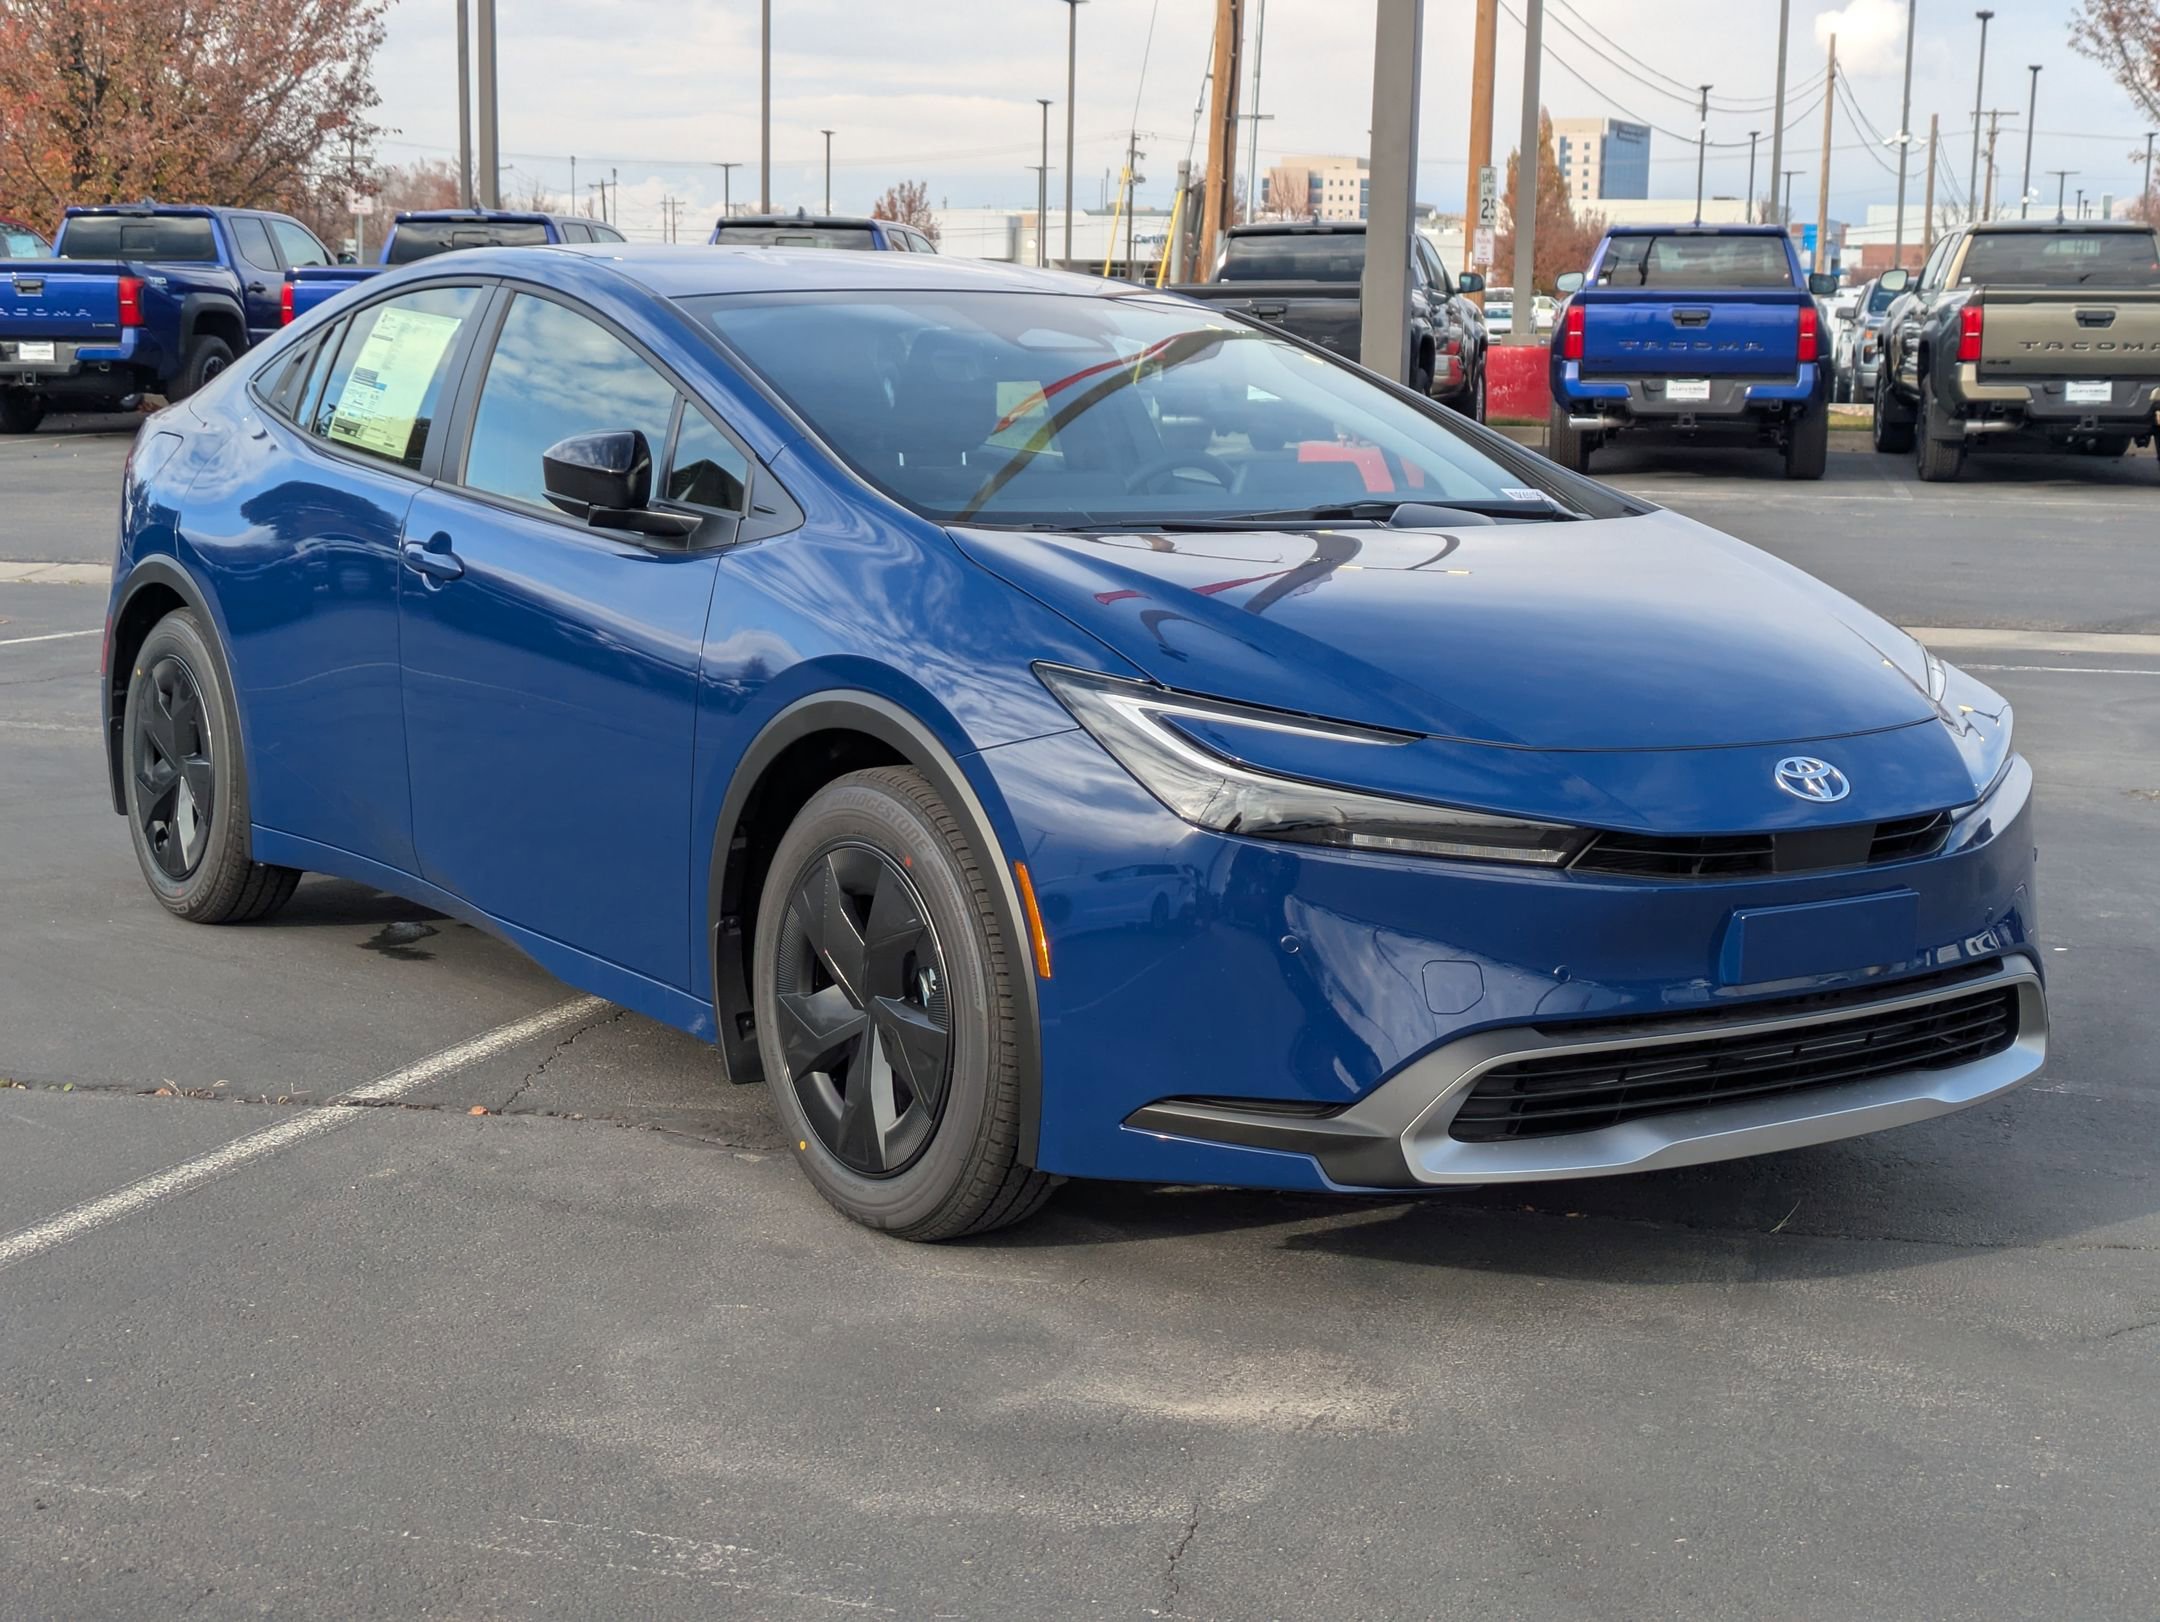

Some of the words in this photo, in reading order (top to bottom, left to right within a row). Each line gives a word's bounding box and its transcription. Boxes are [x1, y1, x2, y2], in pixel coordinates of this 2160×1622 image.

[0, 308, 92, 317] ACOMA
[1619, 341, 1764, 351] TACOMA
[831, 791, 930, 853] BRIDGESTONE
